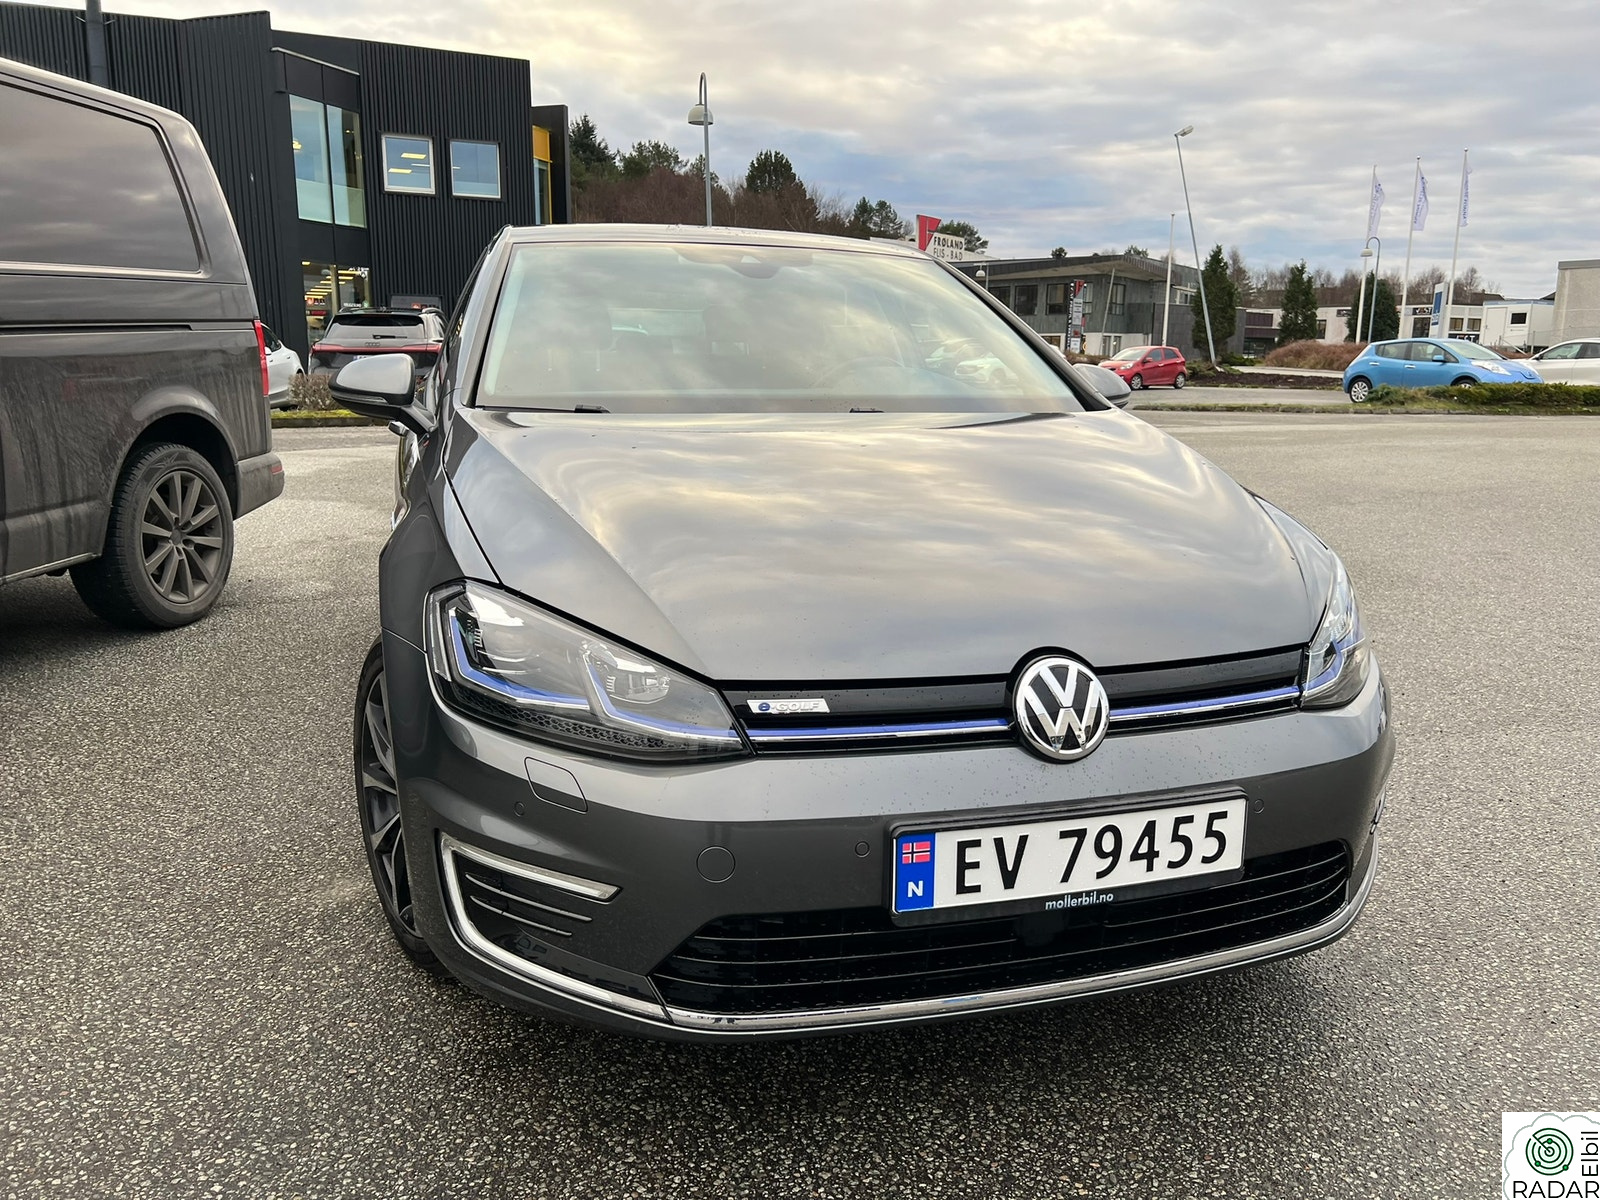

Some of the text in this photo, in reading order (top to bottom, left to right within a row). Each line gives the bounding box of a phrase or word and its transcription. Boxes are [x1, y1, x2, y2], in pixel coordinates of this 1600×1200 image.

[956, 810, 1228, 895] EV 79455
[907, 880, 923, 898] N
[1045, 891, 1114, 910] mollerbil.no
